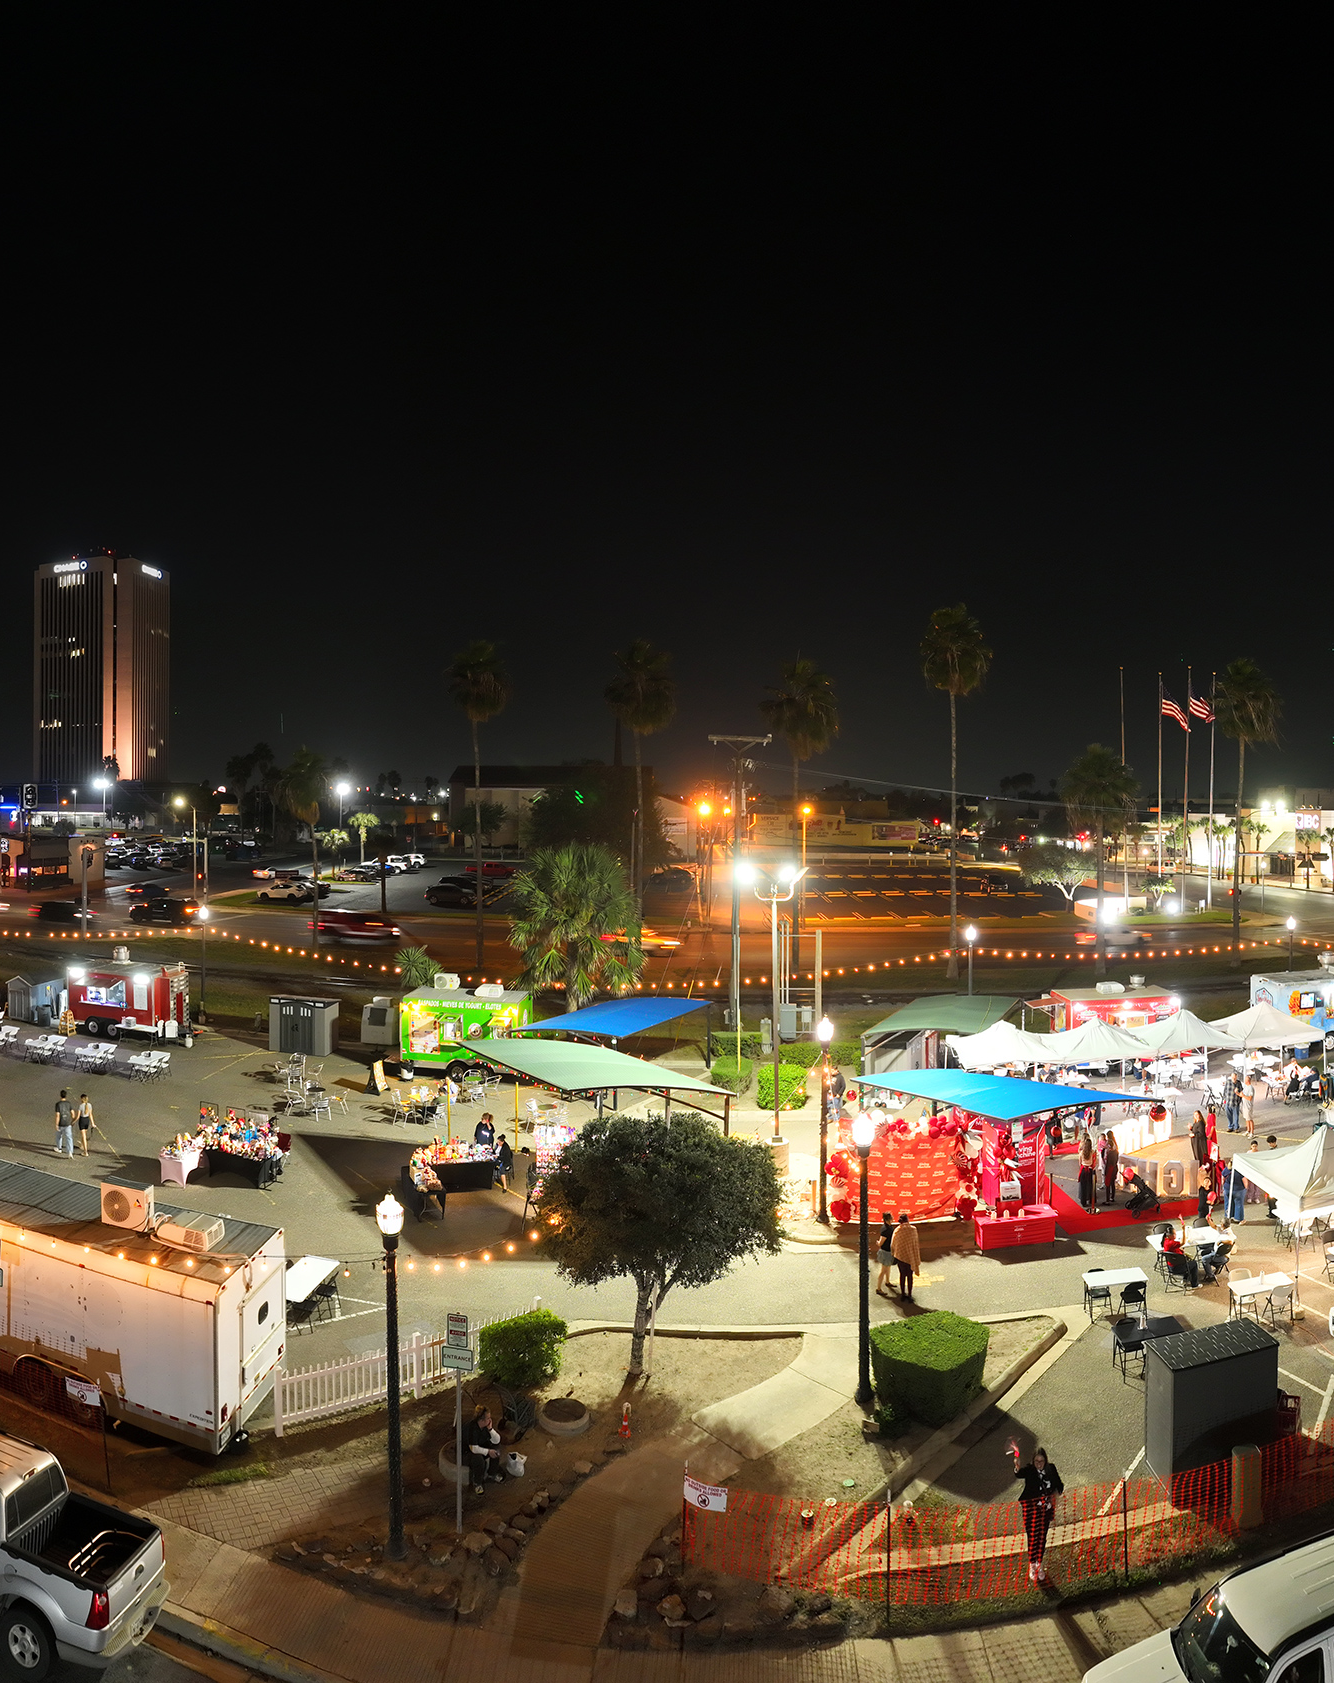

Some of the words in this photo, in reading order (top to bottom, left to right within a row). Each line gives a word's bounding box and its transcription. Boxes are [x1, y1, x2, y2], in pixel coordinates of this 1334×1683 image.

[443, 1354, 472, 1362] ENTRANCE
[688, 1484, 702, 1493] DRINKS
[691, 1480, 707, 1490] OUTSIDE
